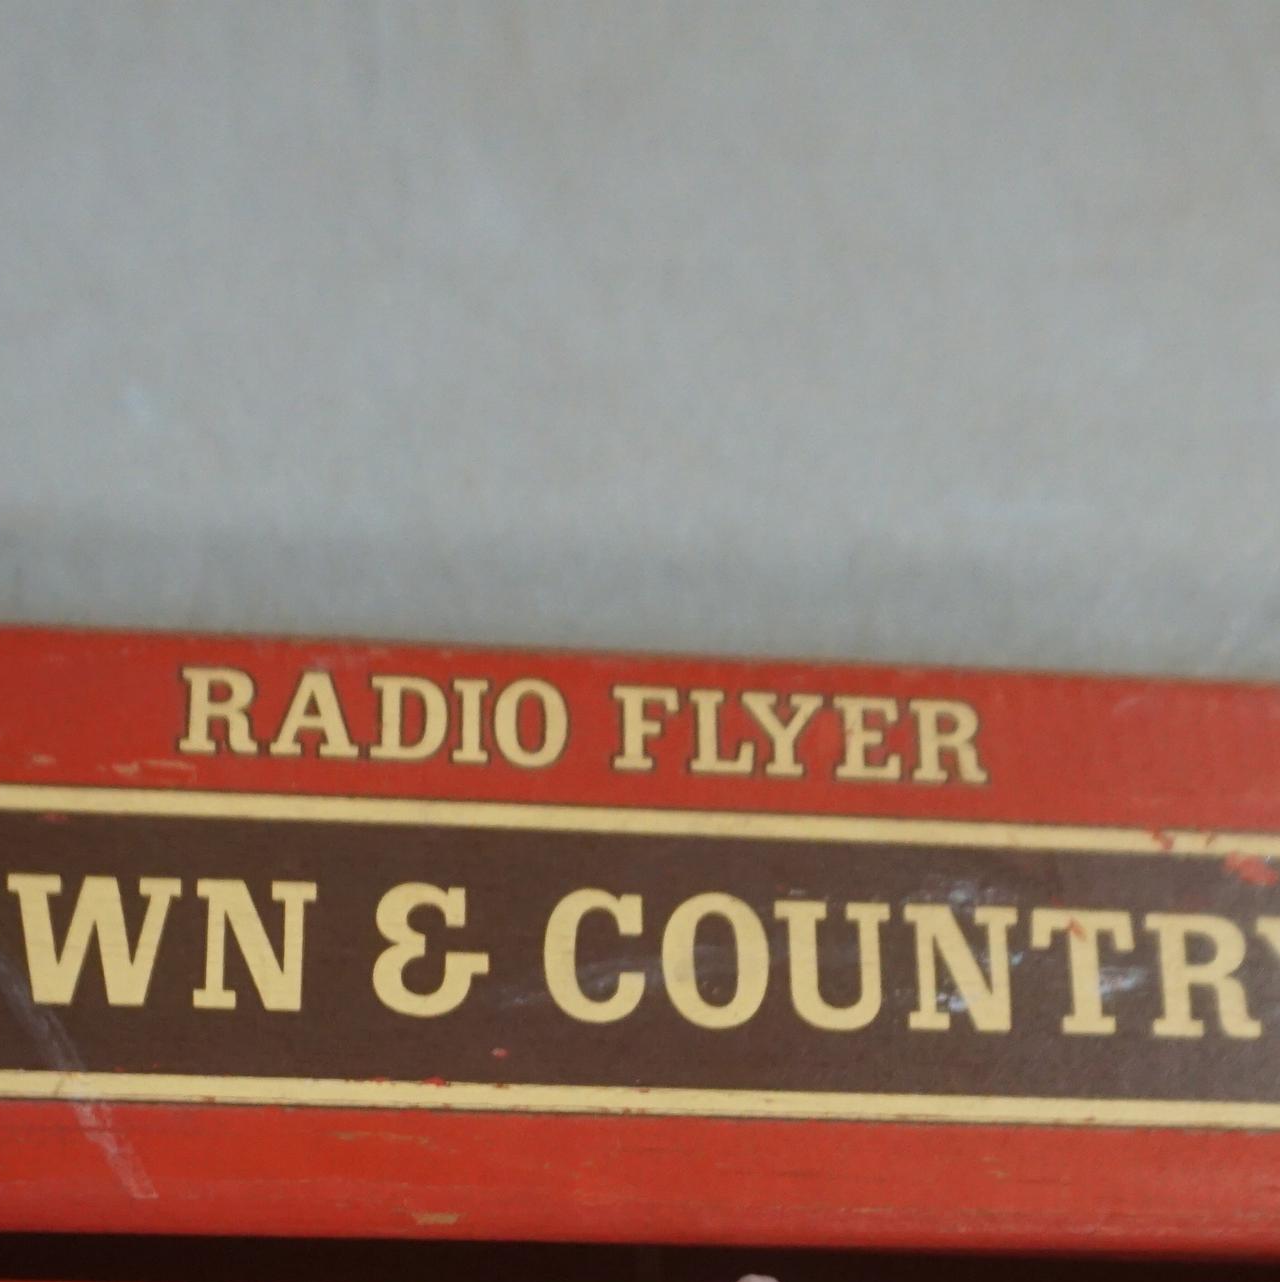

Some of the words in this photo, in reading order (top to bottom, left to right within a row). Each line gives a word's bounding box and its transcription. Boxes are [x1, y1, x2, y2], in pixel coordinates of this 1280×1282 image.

[178, 665, 570, 770] RADIO
[612, 683, 990, 785] FLYER
[372, 881, 490, 1018] &
